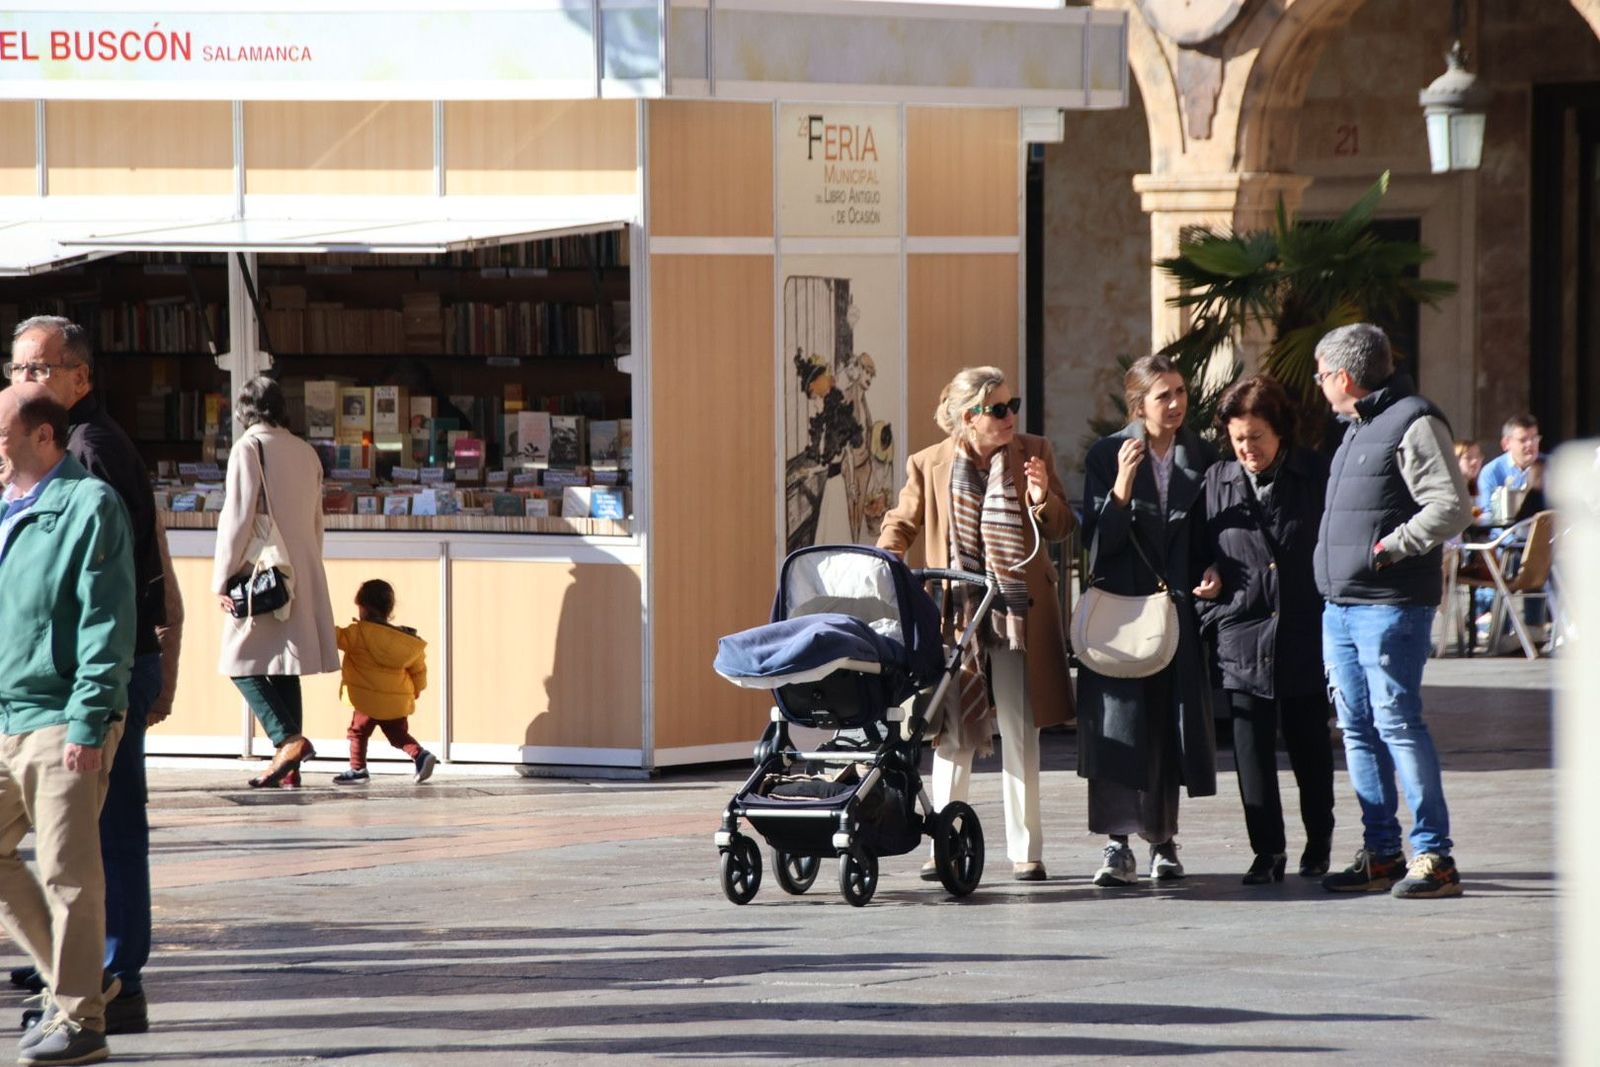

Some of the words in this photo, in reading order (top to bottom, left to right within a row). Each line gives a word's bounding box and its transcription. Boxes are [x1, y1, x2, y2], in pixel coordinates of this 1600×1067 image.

[0, 31, 39, 61] EL
[51, 22, 192, 62] BUSCÓN
[202, 45, 312, 62] SALAMANCA
[808, 114, 879, 161] FERIA
[1334, 125, 1359, 156] 21
[824, 164, 880, 184] MUNICIPAL
[824, 187, 846, 204] LIBRO
